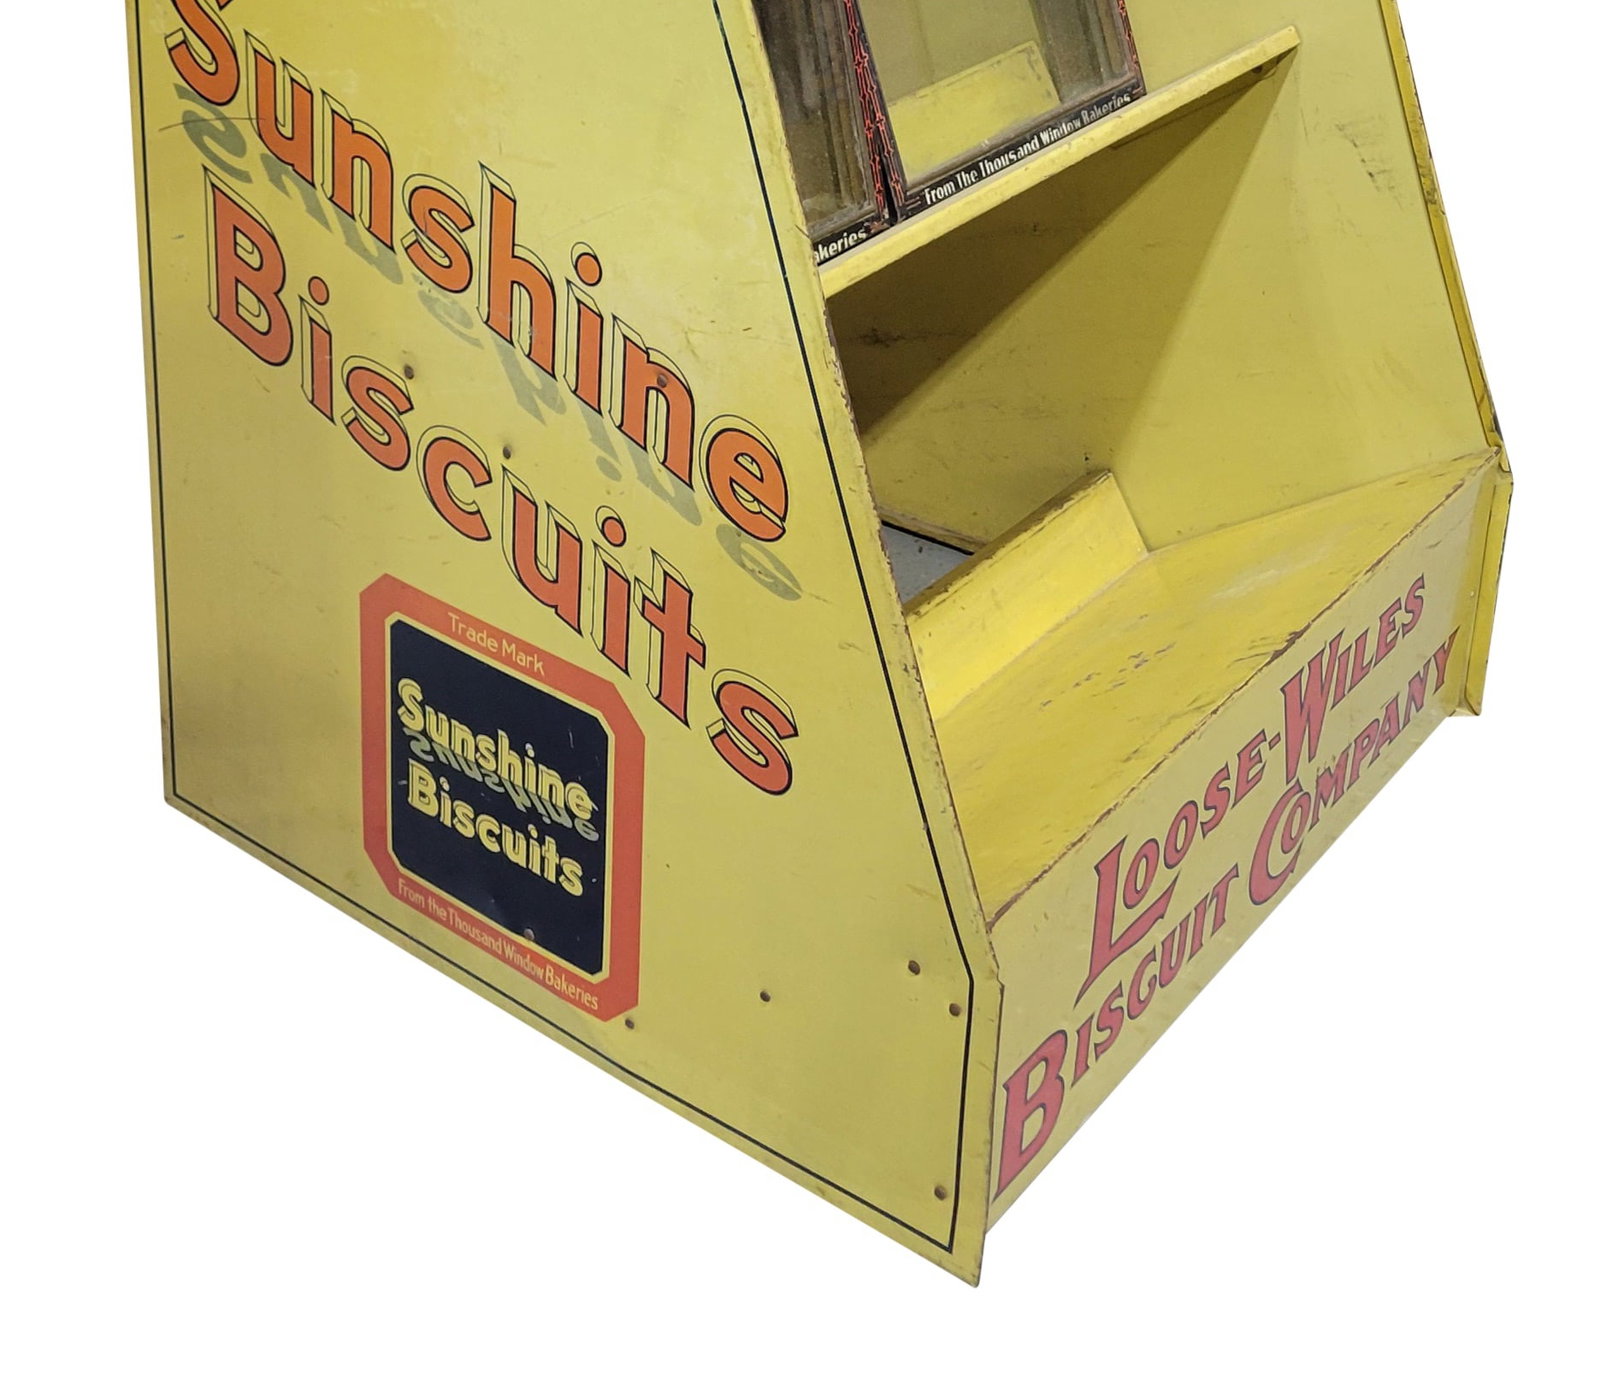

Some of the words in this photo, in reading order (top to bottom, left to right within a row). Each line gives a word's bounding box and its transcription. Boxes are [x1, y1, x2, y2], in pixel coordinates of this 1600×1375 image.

[924, 179, 956, 207] From
[955, 168, 978, 191] The
[980, 134, 1040, 178] Thousand
[1039, 117, 1081, 144] Window
[1080, 92, 1131, 124] Bakeries
[813, 228, 867, 263] akeries
[202, 164, 799, 796] Biscuits
[448, 612, 498, 652] Trade
[502, 642, 545, 676] Mark
[397, 677, 597, 821] Sunshine
[408, 758, 584, 897] Biscuits
[398, 878, 425, 908] From
[428, 895, 448, 922] the
[447, 907, 502, 954] Thousand
[503, 940, 545, 981] Window
[545, 966, 599, 1011] Bakeries
